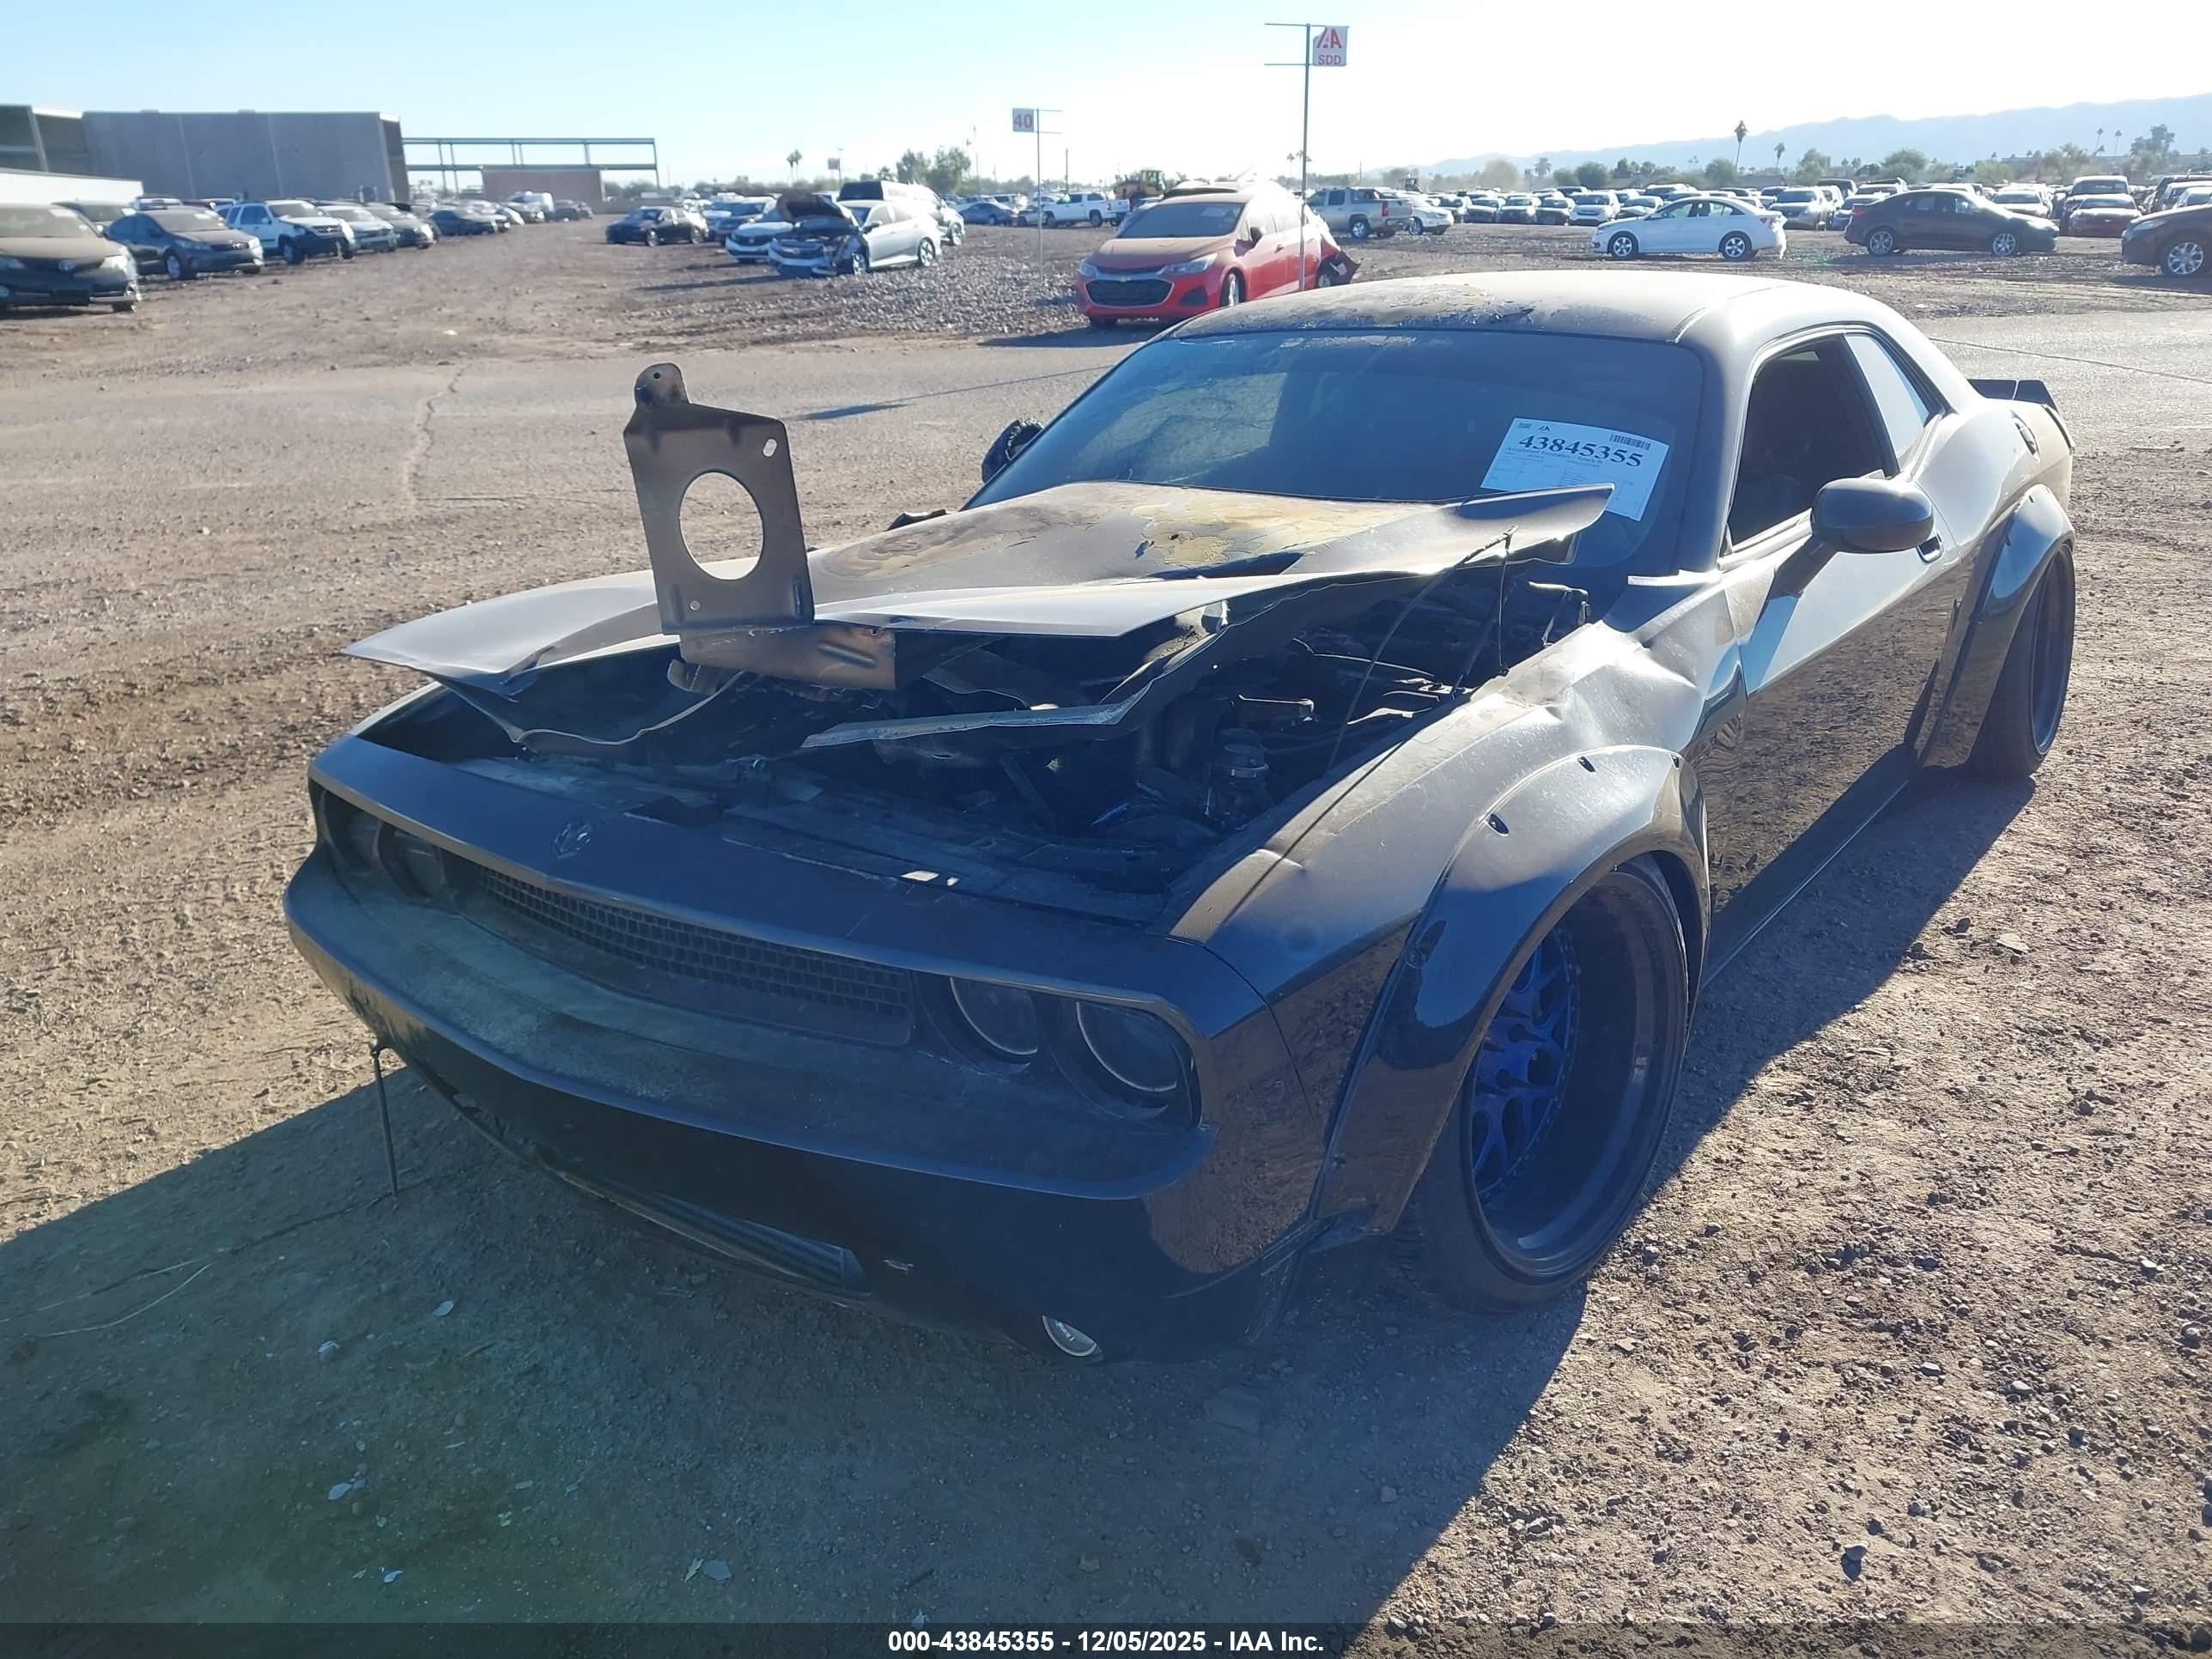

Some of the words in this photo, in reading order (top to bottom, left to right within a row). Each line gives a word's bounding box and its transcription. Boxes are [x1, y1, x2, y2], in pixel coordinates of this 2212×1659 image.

[1318, 55, 1341, 65] SDD
[1014, 113, 1032, 128] 40
[1519, 435, 1644, 467] 43845355
